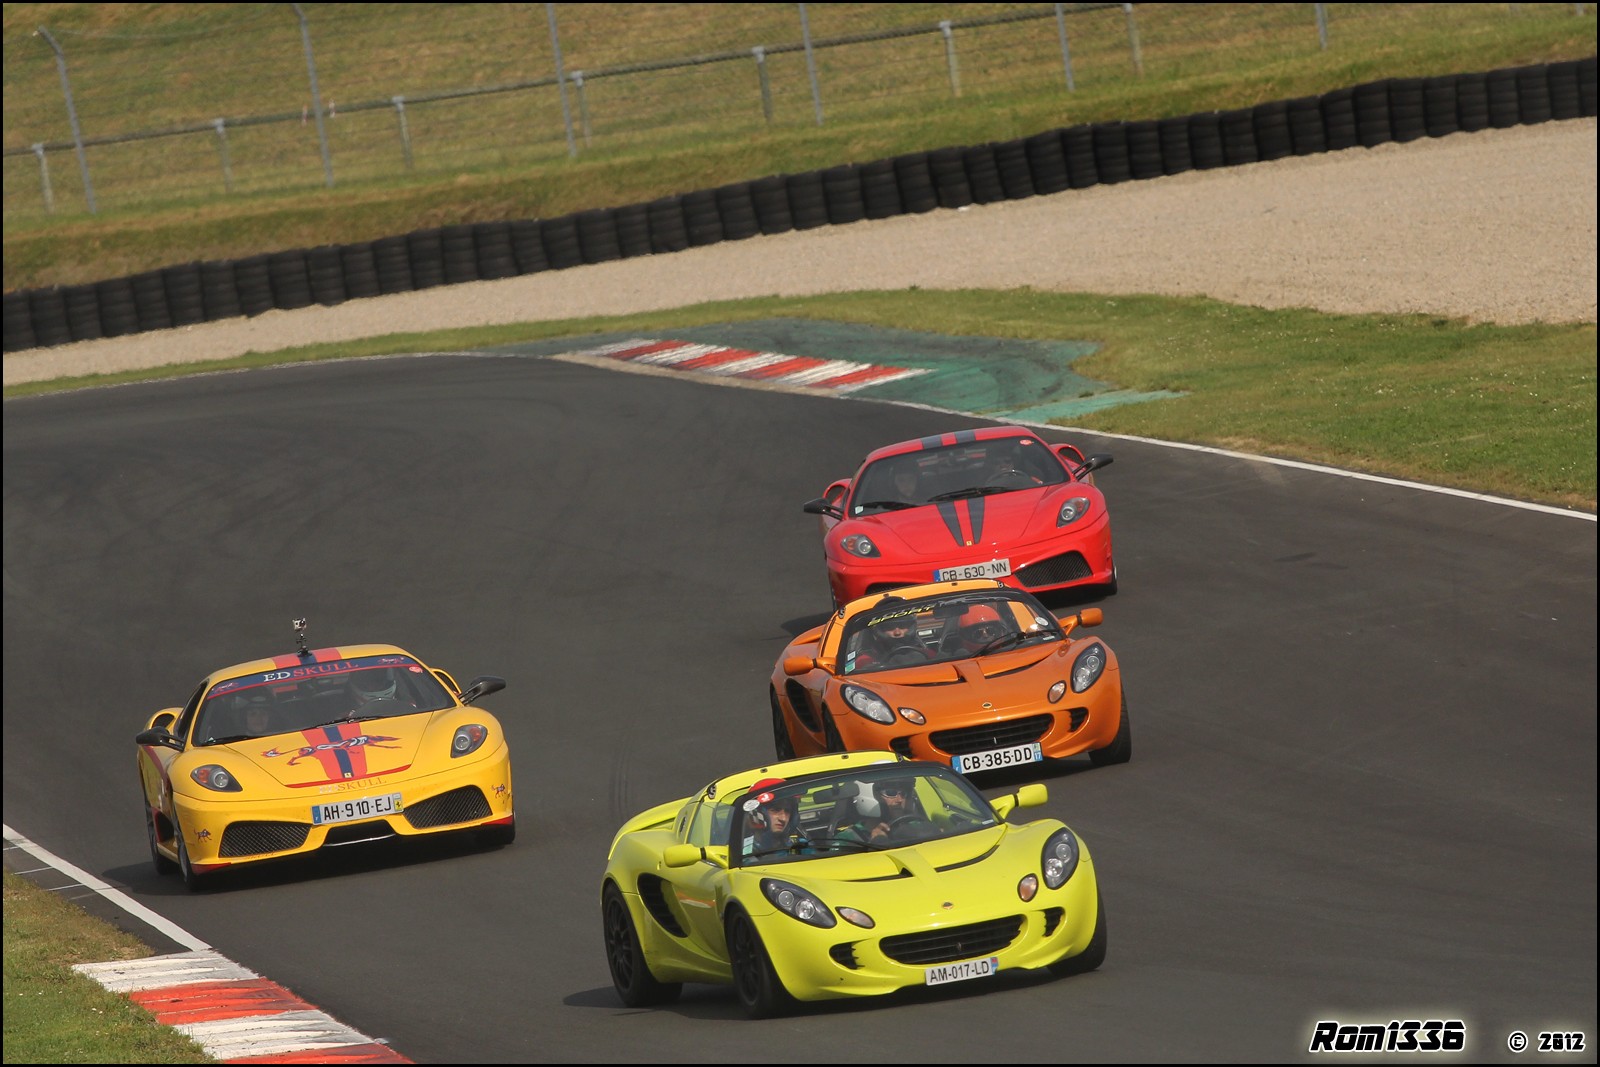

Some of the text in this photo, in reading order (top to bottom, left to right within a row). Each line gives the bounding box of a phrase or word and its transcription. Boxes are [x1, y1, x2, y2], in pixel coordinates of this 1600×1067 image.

[942, 562, 1007, 581] CB-630-NN
[293, 661, 359, 678] SKULL
[962, 747, 1032, 771] CB-385-DD
[324, 796, 392, 821] AH-910-EJ
[930, 961, 990, 983] AM-017-LD
